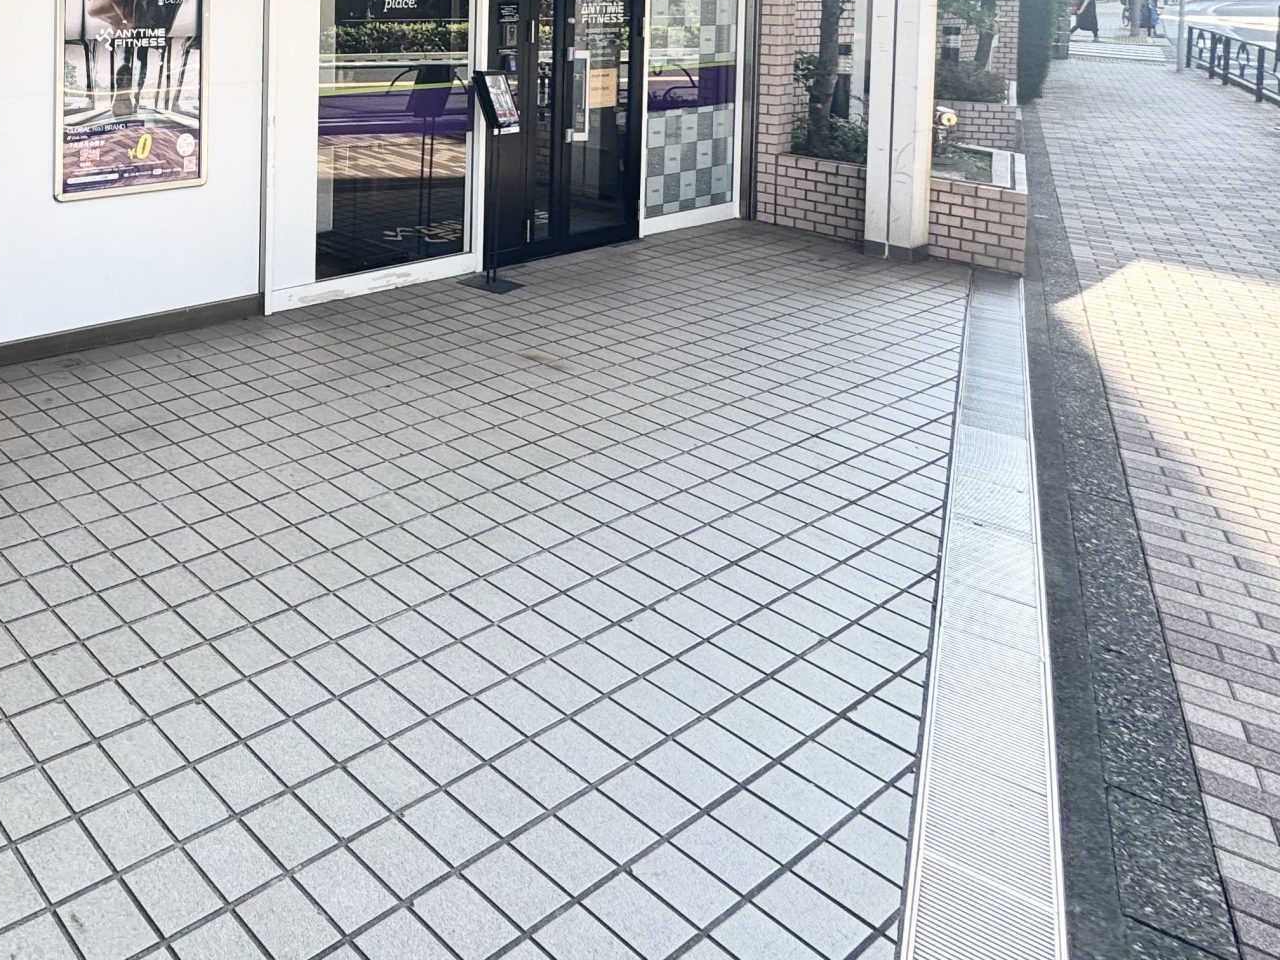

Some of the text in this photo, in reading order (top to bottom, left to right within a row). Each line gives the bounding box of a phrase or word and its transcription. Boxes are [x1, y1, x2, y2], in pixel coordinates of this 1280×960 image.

[581, 2, 625, 14] ANYTIME
[581, 13, 625, 24] FITNESS
[115, 28, 166, 38] ANYTIME
[115, 38, 167, 48] FITNESS
[104, 123, 126, 132] BRAND
